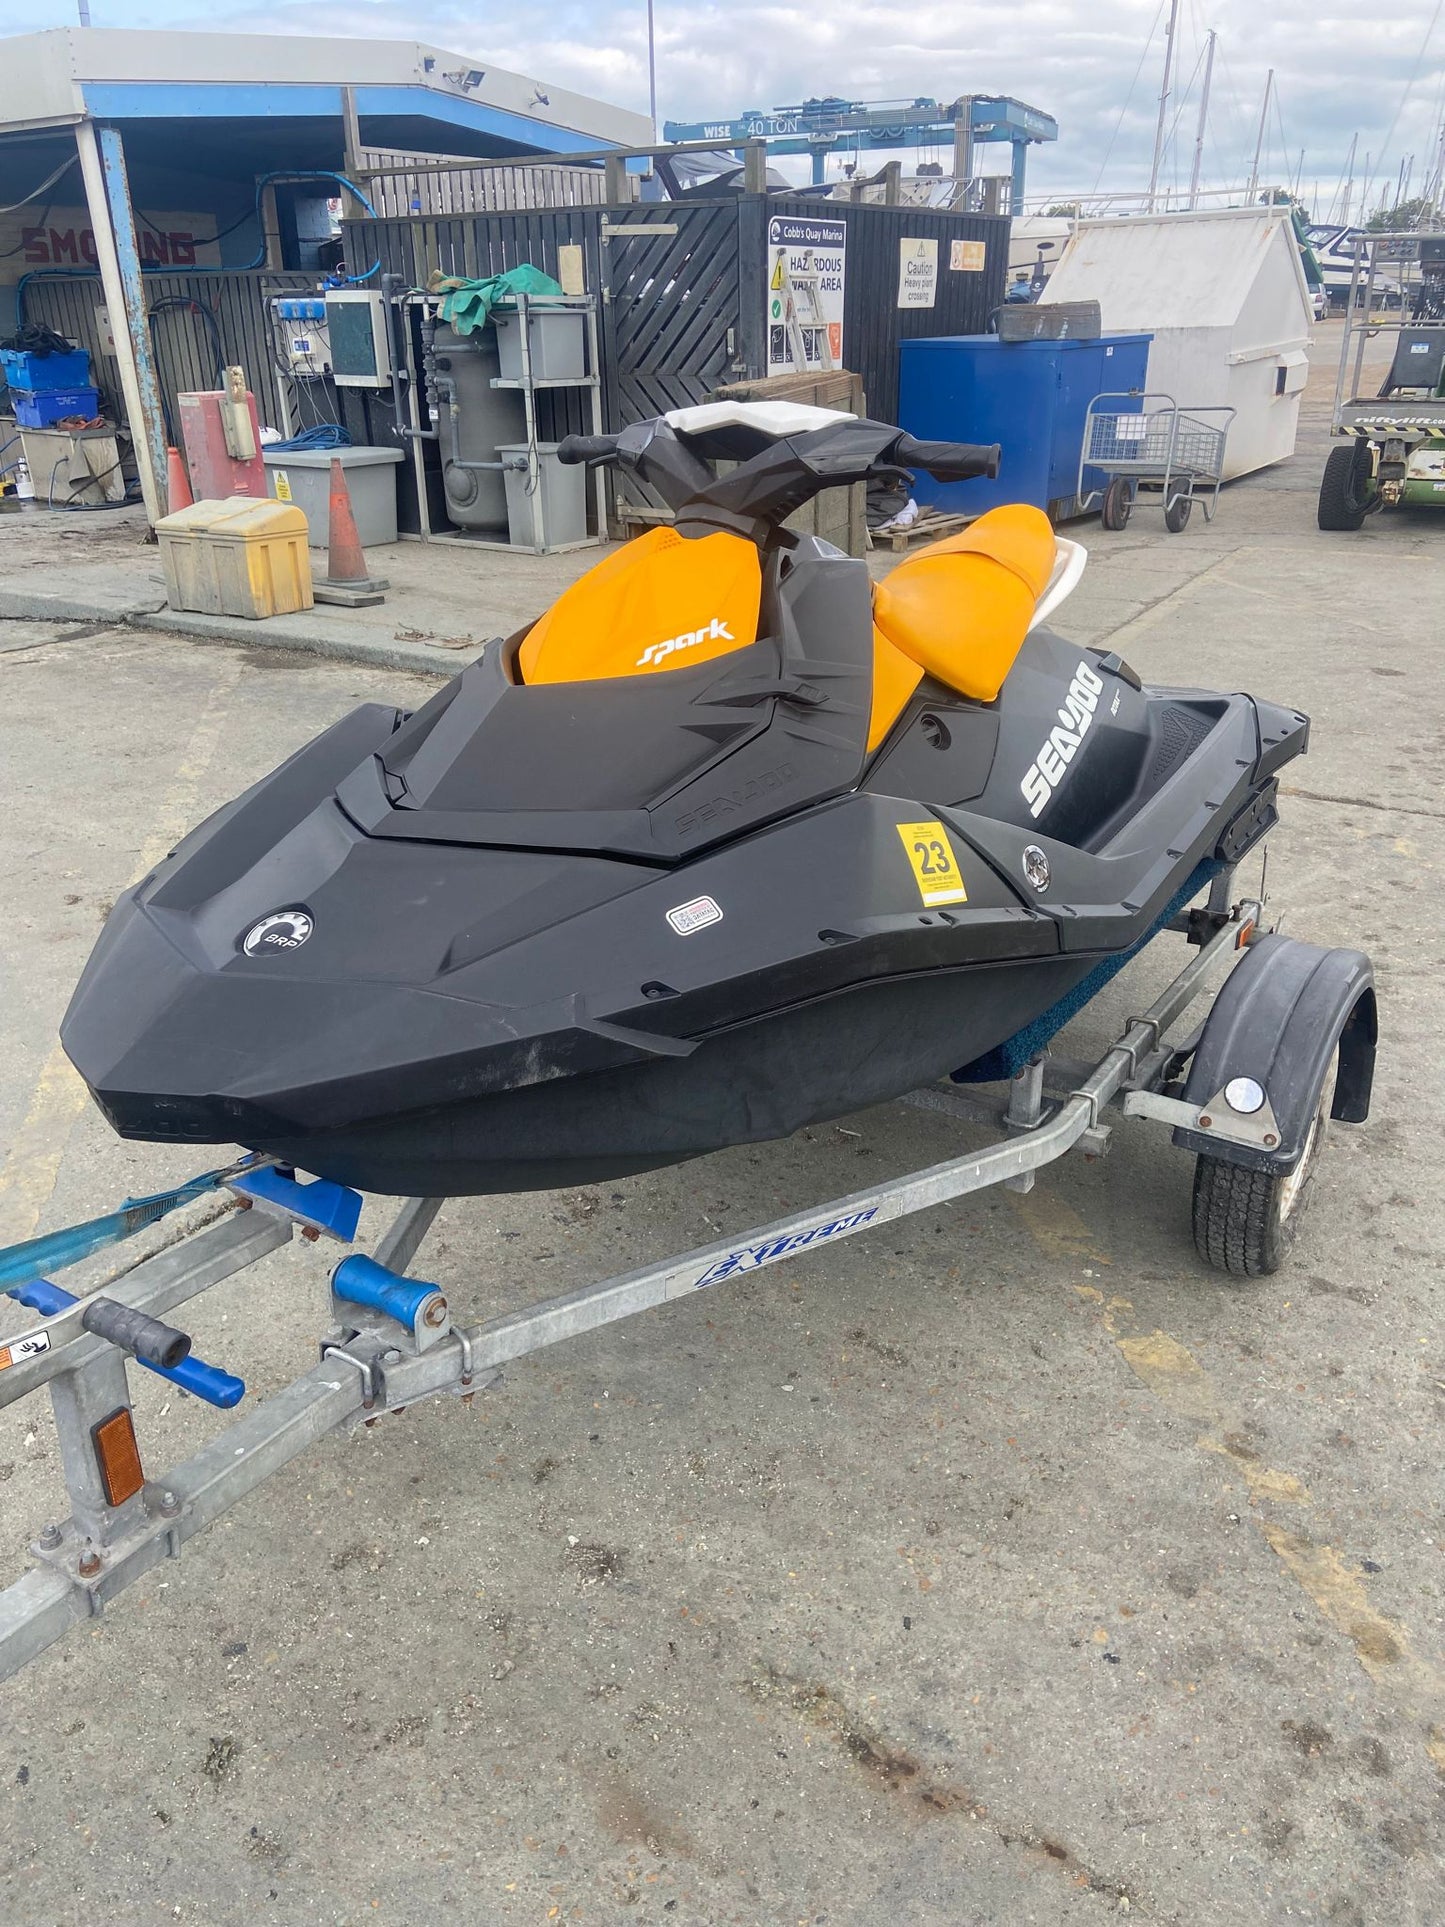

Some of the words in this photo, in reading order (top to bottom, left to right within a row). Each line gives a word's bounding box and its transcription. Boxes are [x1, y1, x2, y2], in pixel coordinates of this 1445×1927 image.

[704, 125, 731, 138] WISE
[747, 120, 764, 135] 40
[767, 118, 798, 134] TON
[783, 225, 805, 239] Cobb's
[805, 227, 821, 242] Quay
[822, 228, 843, 241] Marina
[790, 256, 842, 272] HAZRDOUS
[907, 261, 933, 275] Caution
[820, 277, 842, 291] AREA
[904, 278, 921, 289] Heavy
[1354, 416, 1445, 425] niftylift.co
[635, 617, 736, 666] spark
[913, 841, 952, 875] 23
[264, 933, 299, 948] BRP
[694, 1206, 880, 1288] EXTREME
